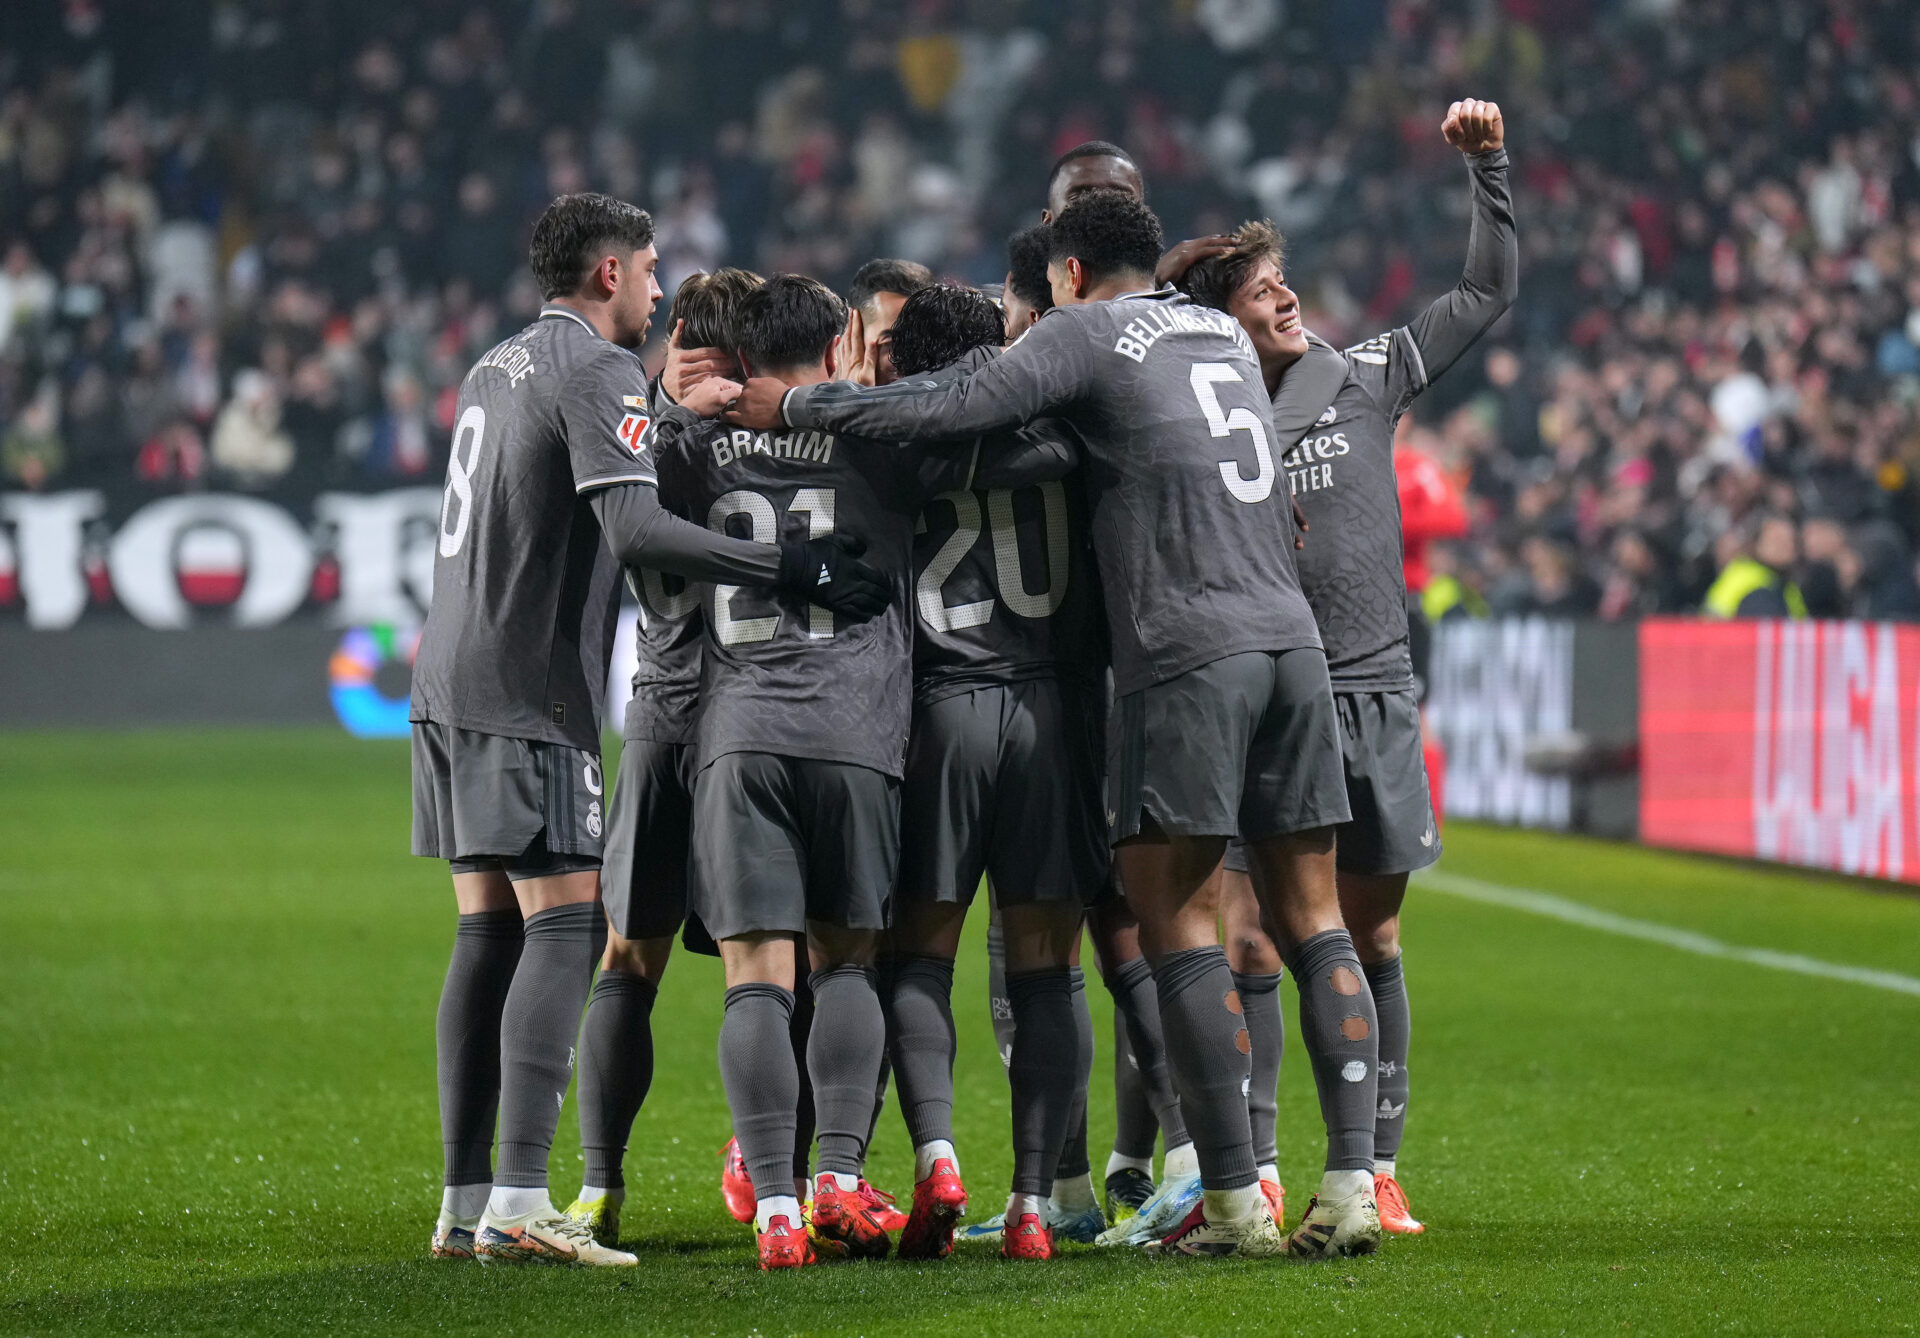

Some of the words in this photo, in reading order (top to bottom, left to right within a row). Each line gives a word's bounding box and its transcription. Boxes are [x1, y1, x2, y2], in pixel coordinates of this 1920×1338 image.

[440, 405, 486, 558] 8
[711, 429, 835, 468] BRAHIM
[1189, 361, 1275, 504] 5
[706, 487, 836, 646] 21
[896, 479, 1069, 633] 20
